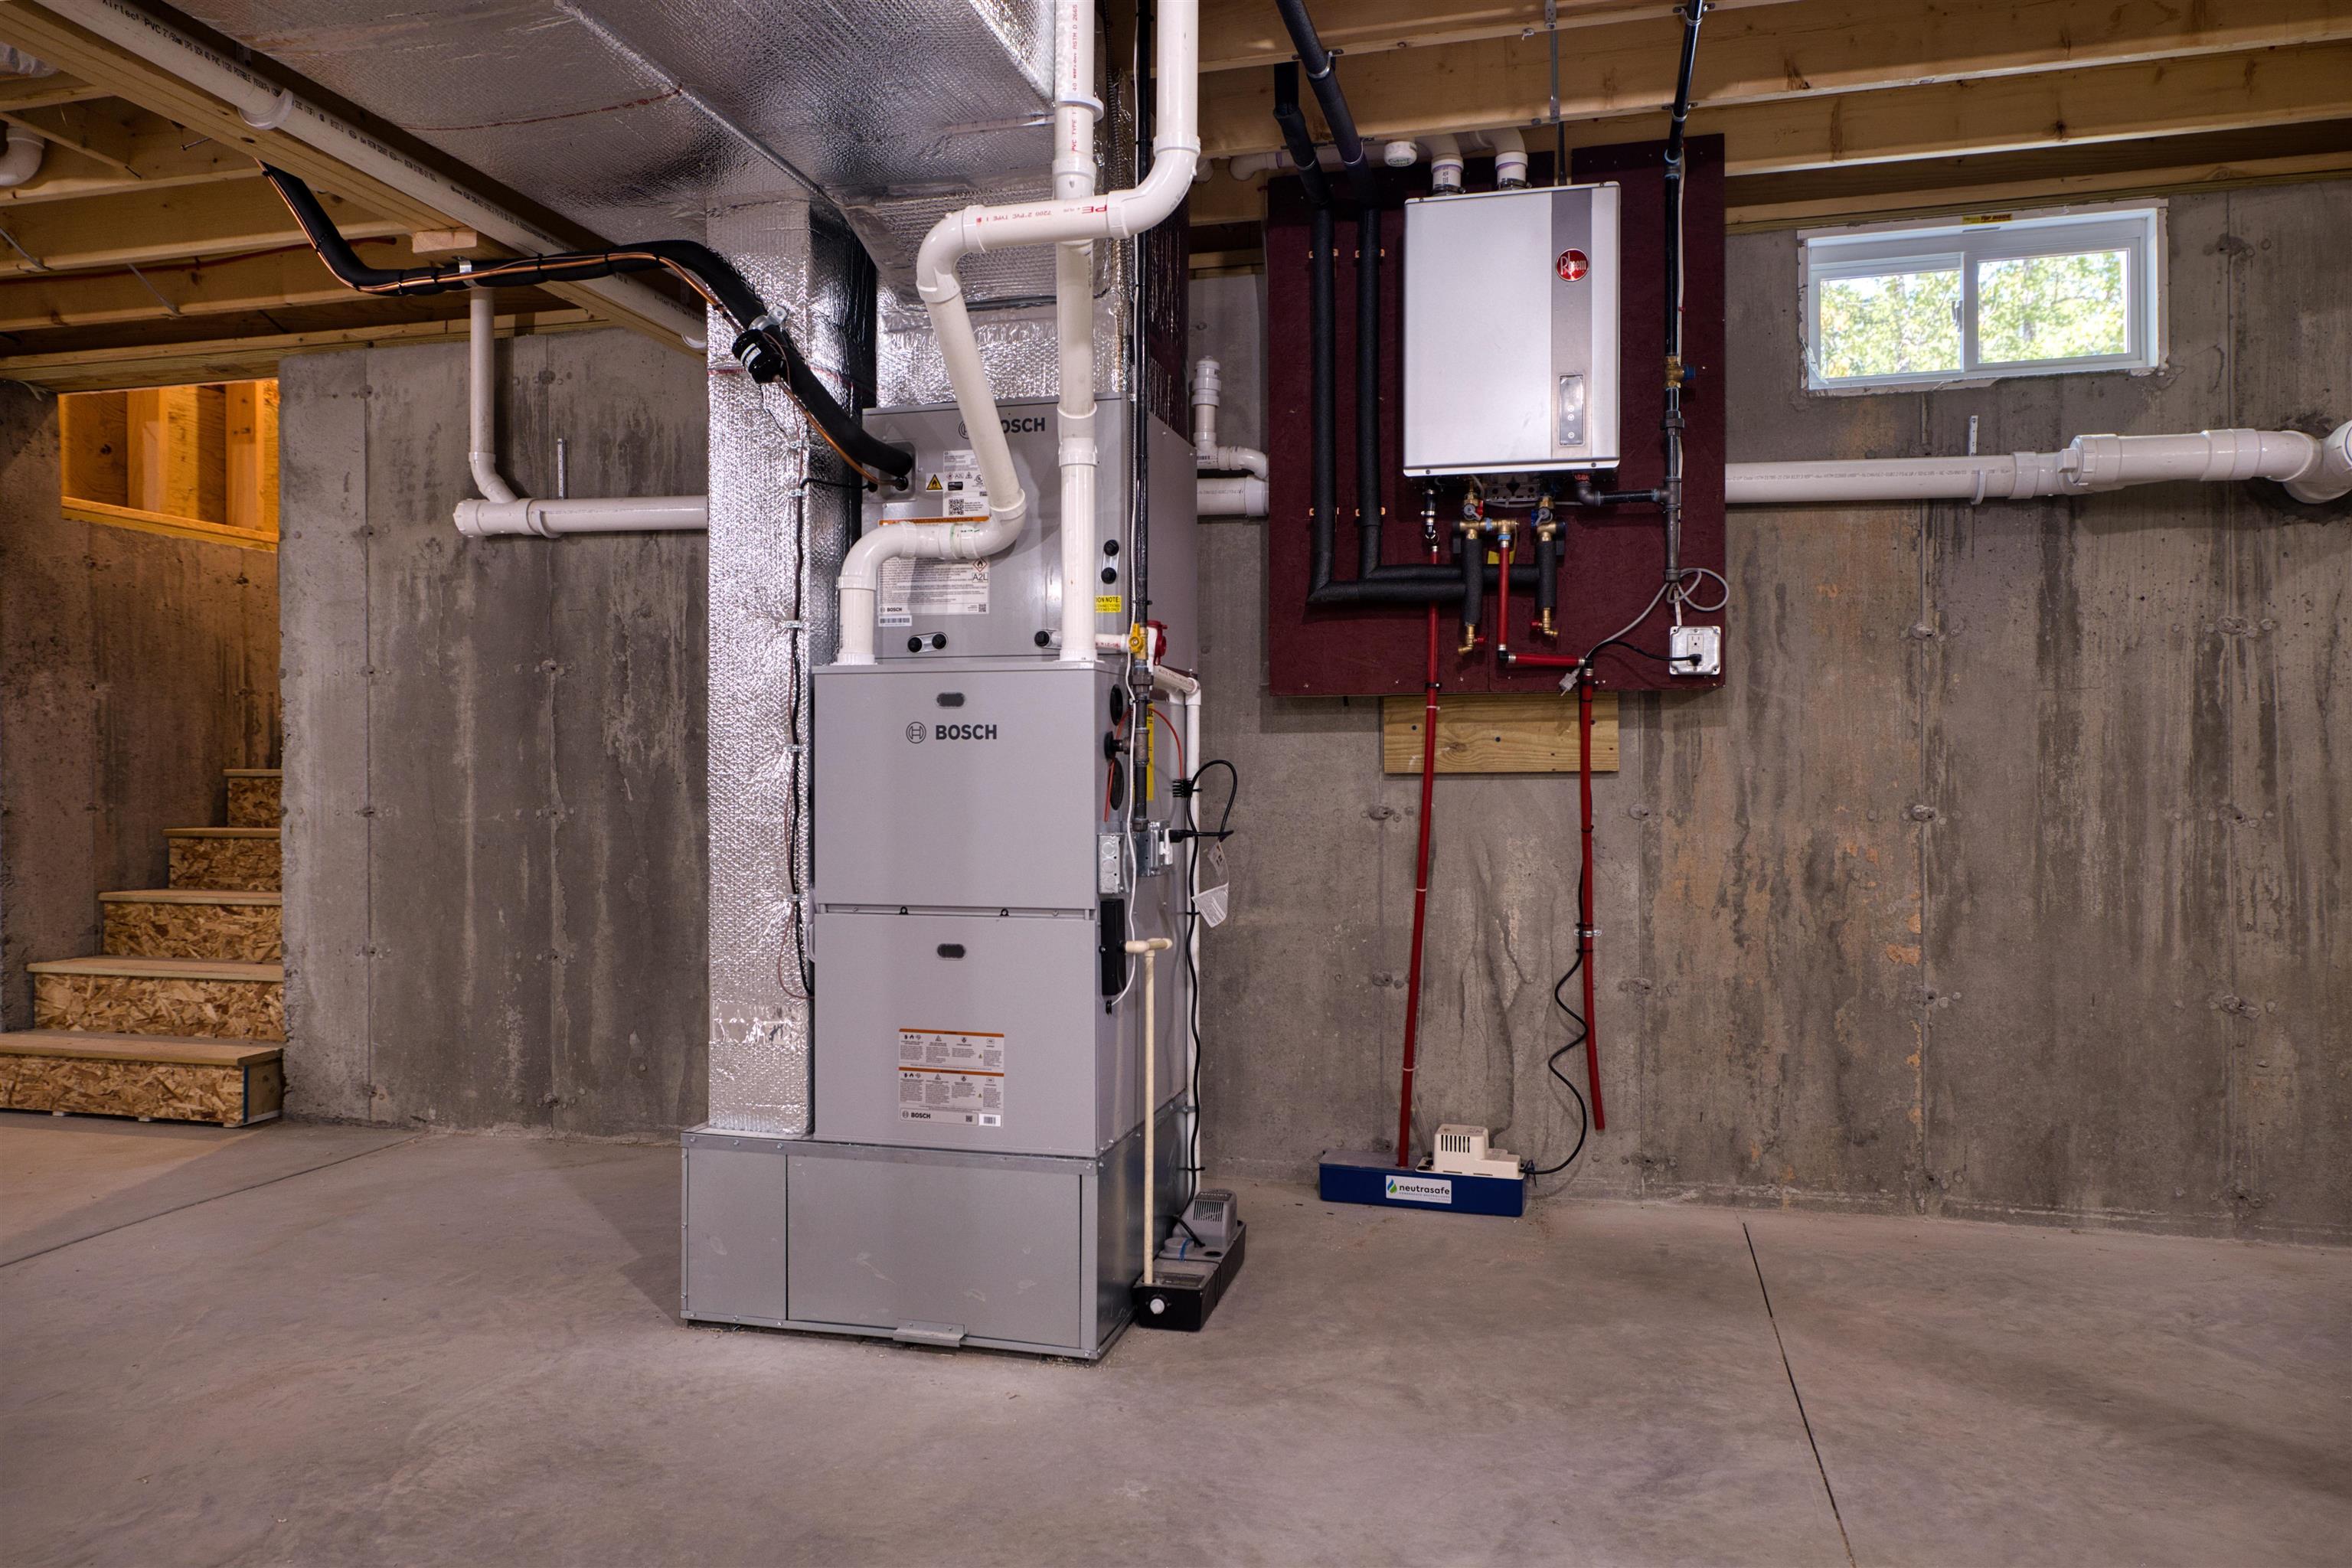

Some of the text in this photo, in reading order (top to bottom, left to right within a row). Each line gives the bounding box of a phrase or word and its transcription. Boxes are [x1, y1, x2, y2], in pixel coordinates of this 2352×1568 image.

[1072, 83, 1077, 91] 40
[1560, 251, 1587, 276] Rheem
[1000, 417, 1046, 435] OSCH
[972, 573, 989, 582] A2L
[935, 724, 998, 741] BOSCH
[1399, 1184, 1450, 1195] neutrasafe
